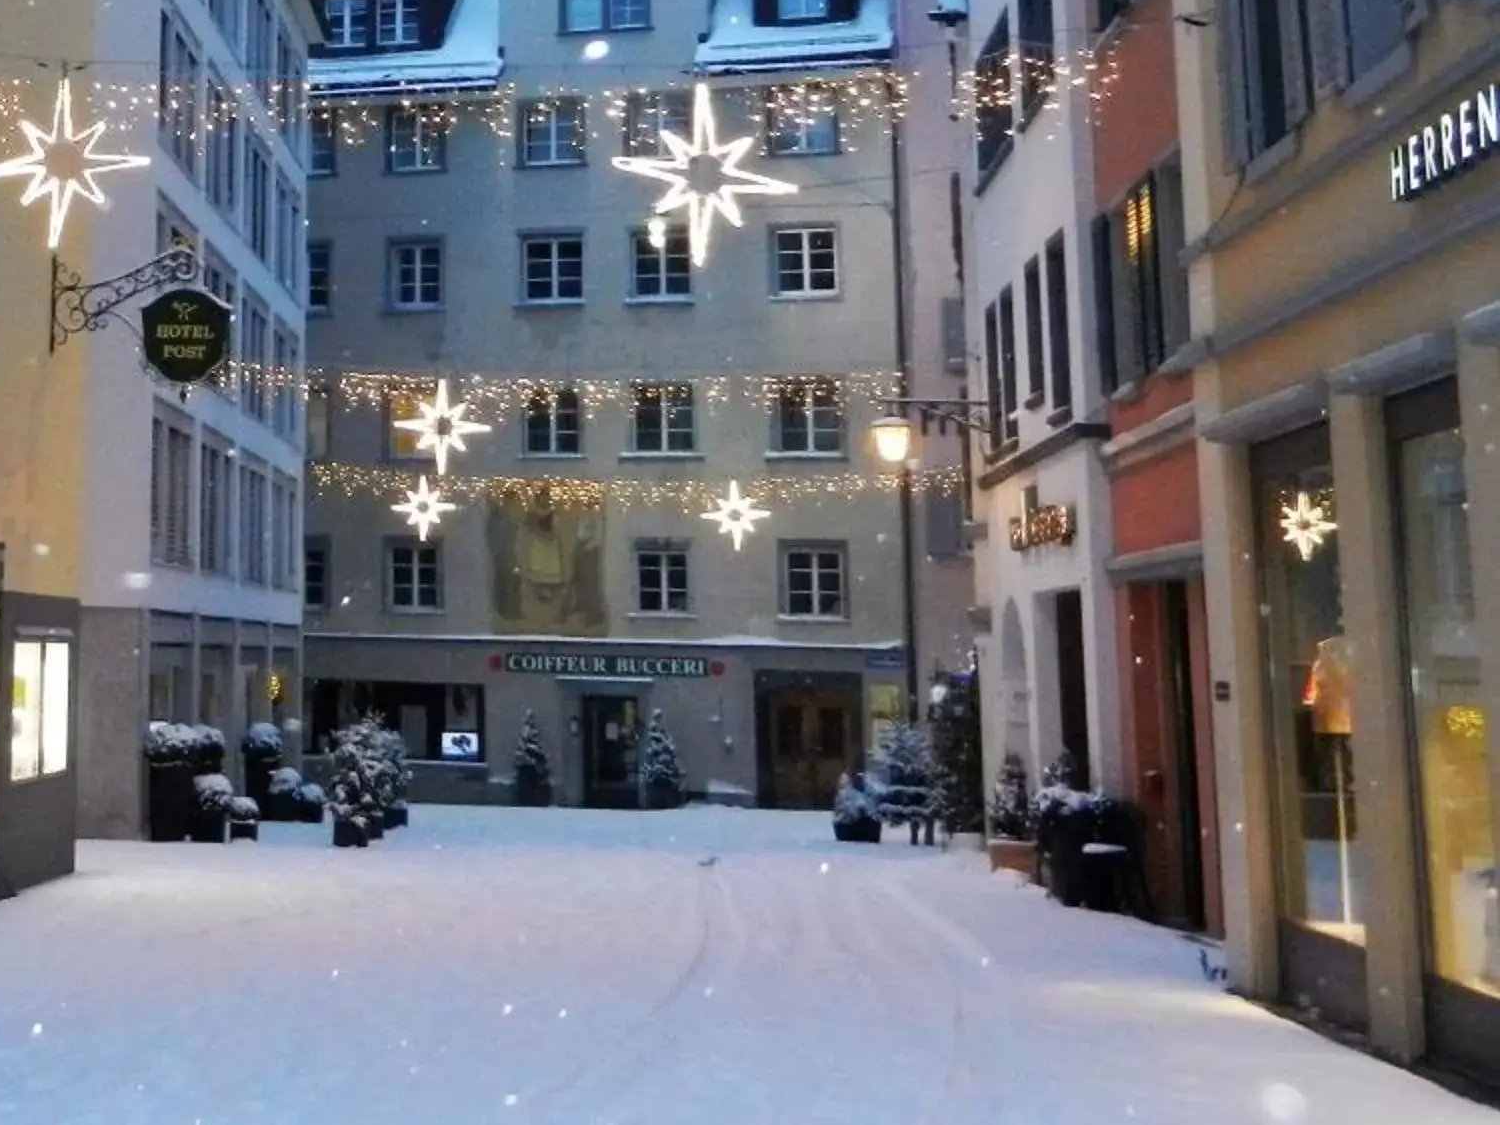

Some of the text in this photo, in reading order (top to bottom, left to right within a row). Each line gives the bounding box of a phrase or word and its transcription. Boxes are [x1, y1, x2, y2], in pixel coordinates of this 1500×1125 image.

[1389, 83, 1500, 202] HERREN
[155, 323, 216, 340] HOTEL
[163, 344, 207, 360] POST
[507, 654, 705, 675] COIFFEUR BUCCERI
